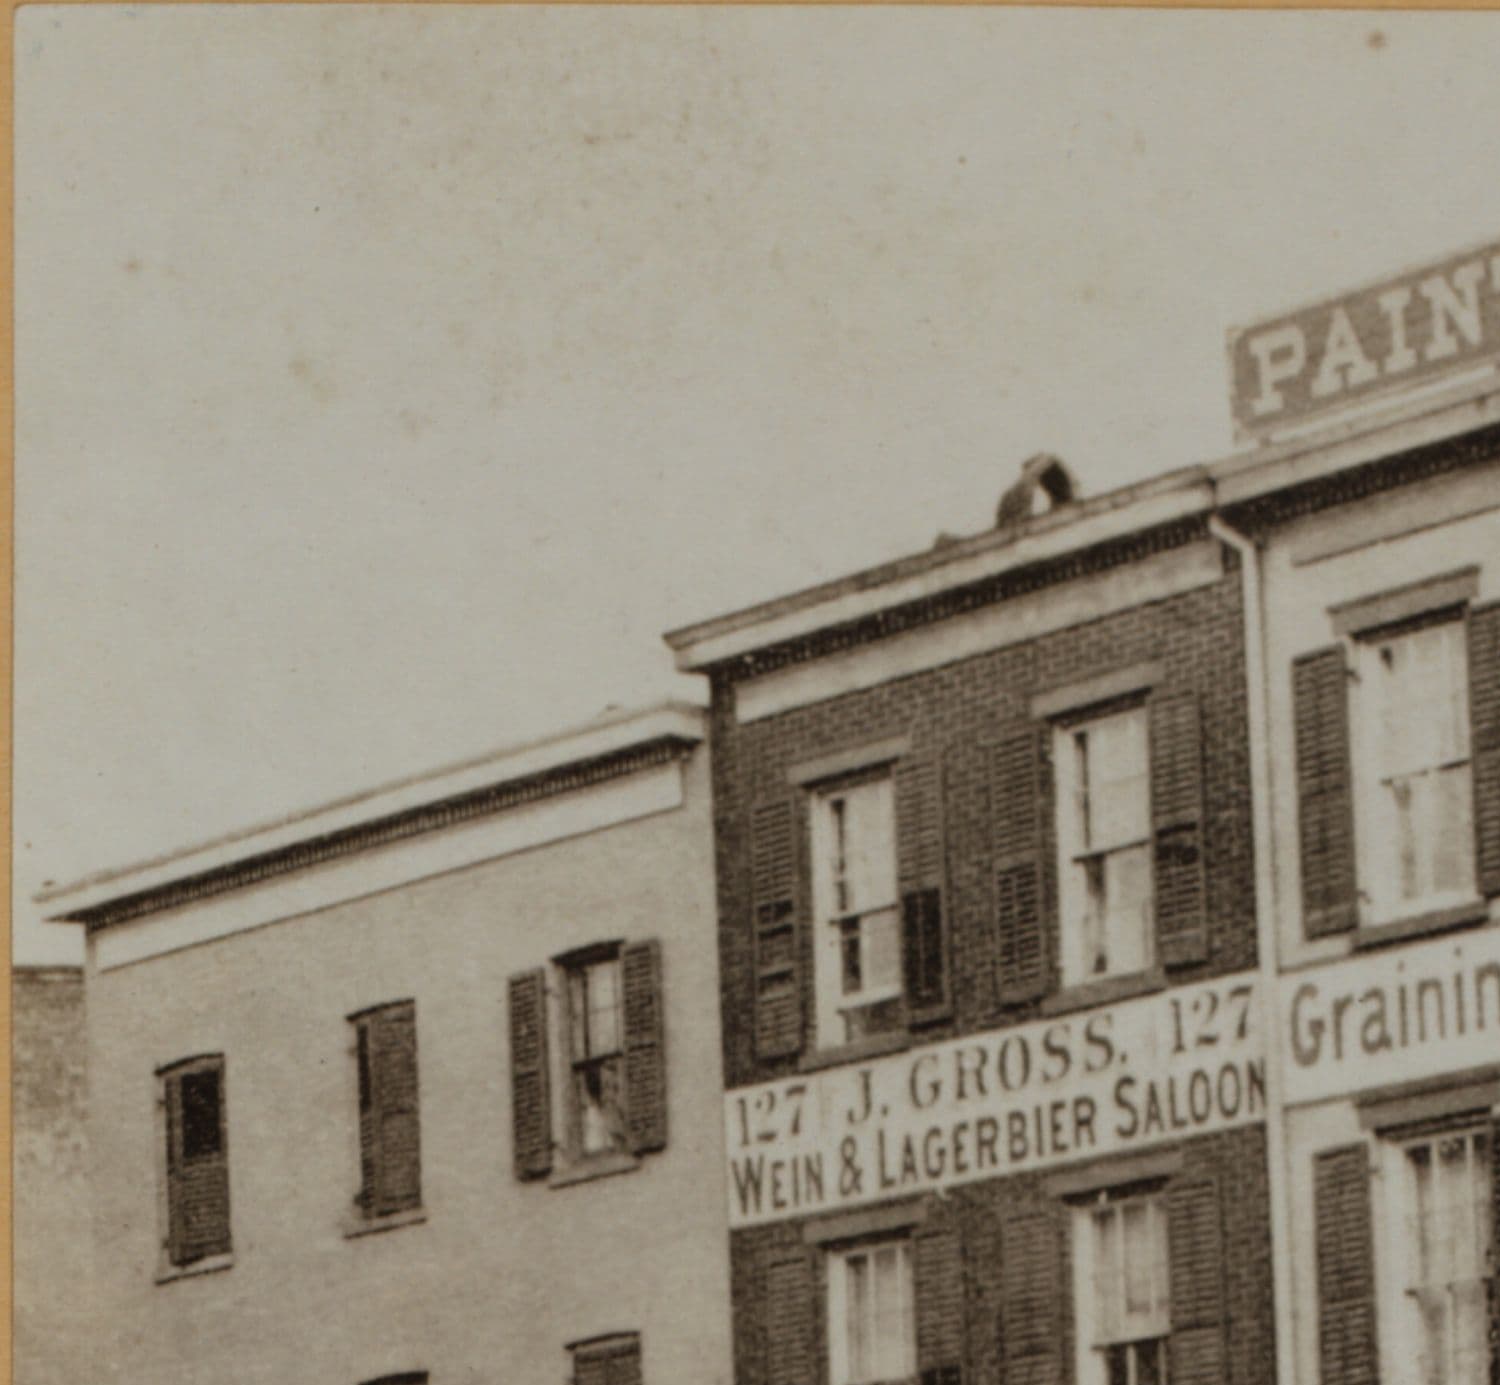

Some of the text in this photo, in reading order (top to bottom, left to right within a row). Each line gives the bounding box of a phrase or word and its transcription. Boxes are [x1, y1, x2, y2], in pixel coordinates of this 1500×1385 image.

[736, 984, 1255, 1147] 127 J. GROSS. 127
[839, 1134, 863, 1194] &
[878, 1096, 1099, 1189] LAGERBIER
